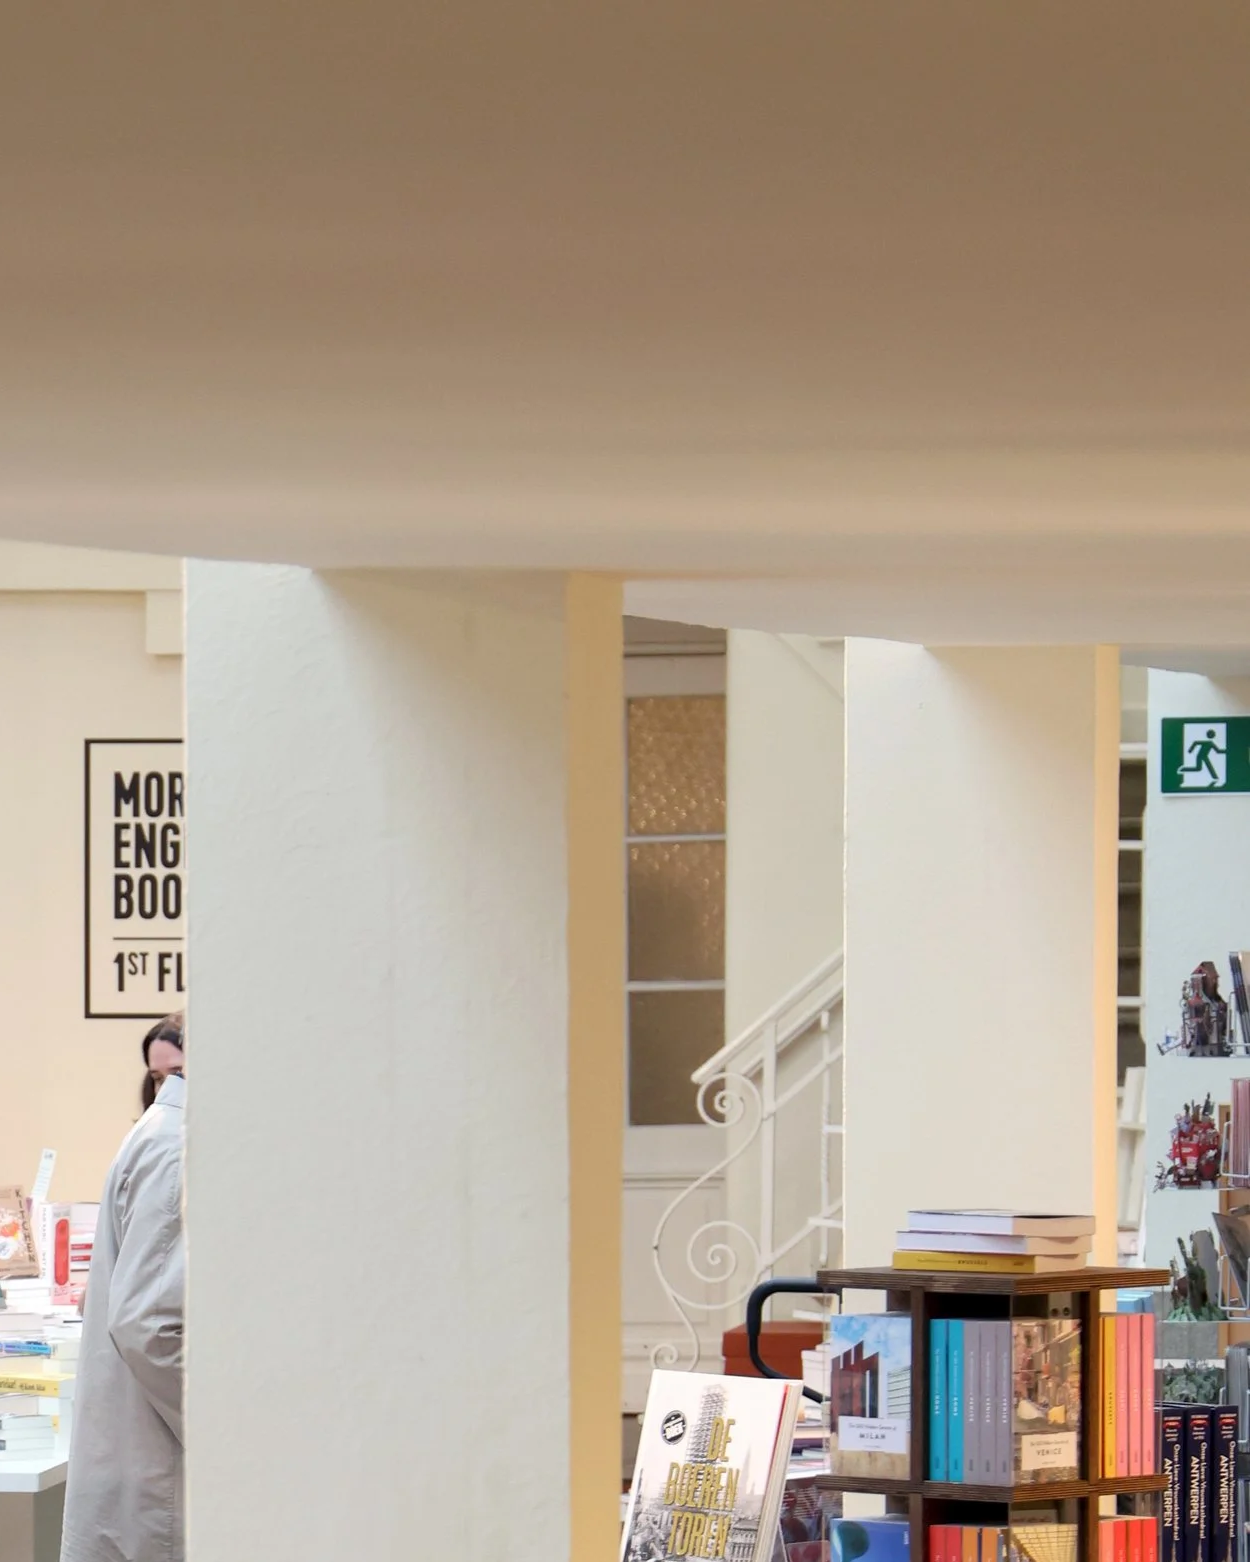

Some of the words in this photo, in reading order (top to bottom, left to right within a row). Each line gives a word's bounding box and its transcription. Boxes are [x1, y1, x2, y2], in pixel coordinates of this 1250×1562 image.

[14, 1189, 36, 1263] KITCHEN
[707, 1416, 735, 1464] DE
[859, 1432, 887, 1440] MILAN
[1037, 1448, 1062, 1457] VENICE
[663, 1461, 740, 1513] BOEREN
[1190, 1455, 1200, 1526] ANTWERPEN
[1219, 1454, 1229, 1525] ANTWERPEN
[667, 1509, 733, 1559] TOREN
